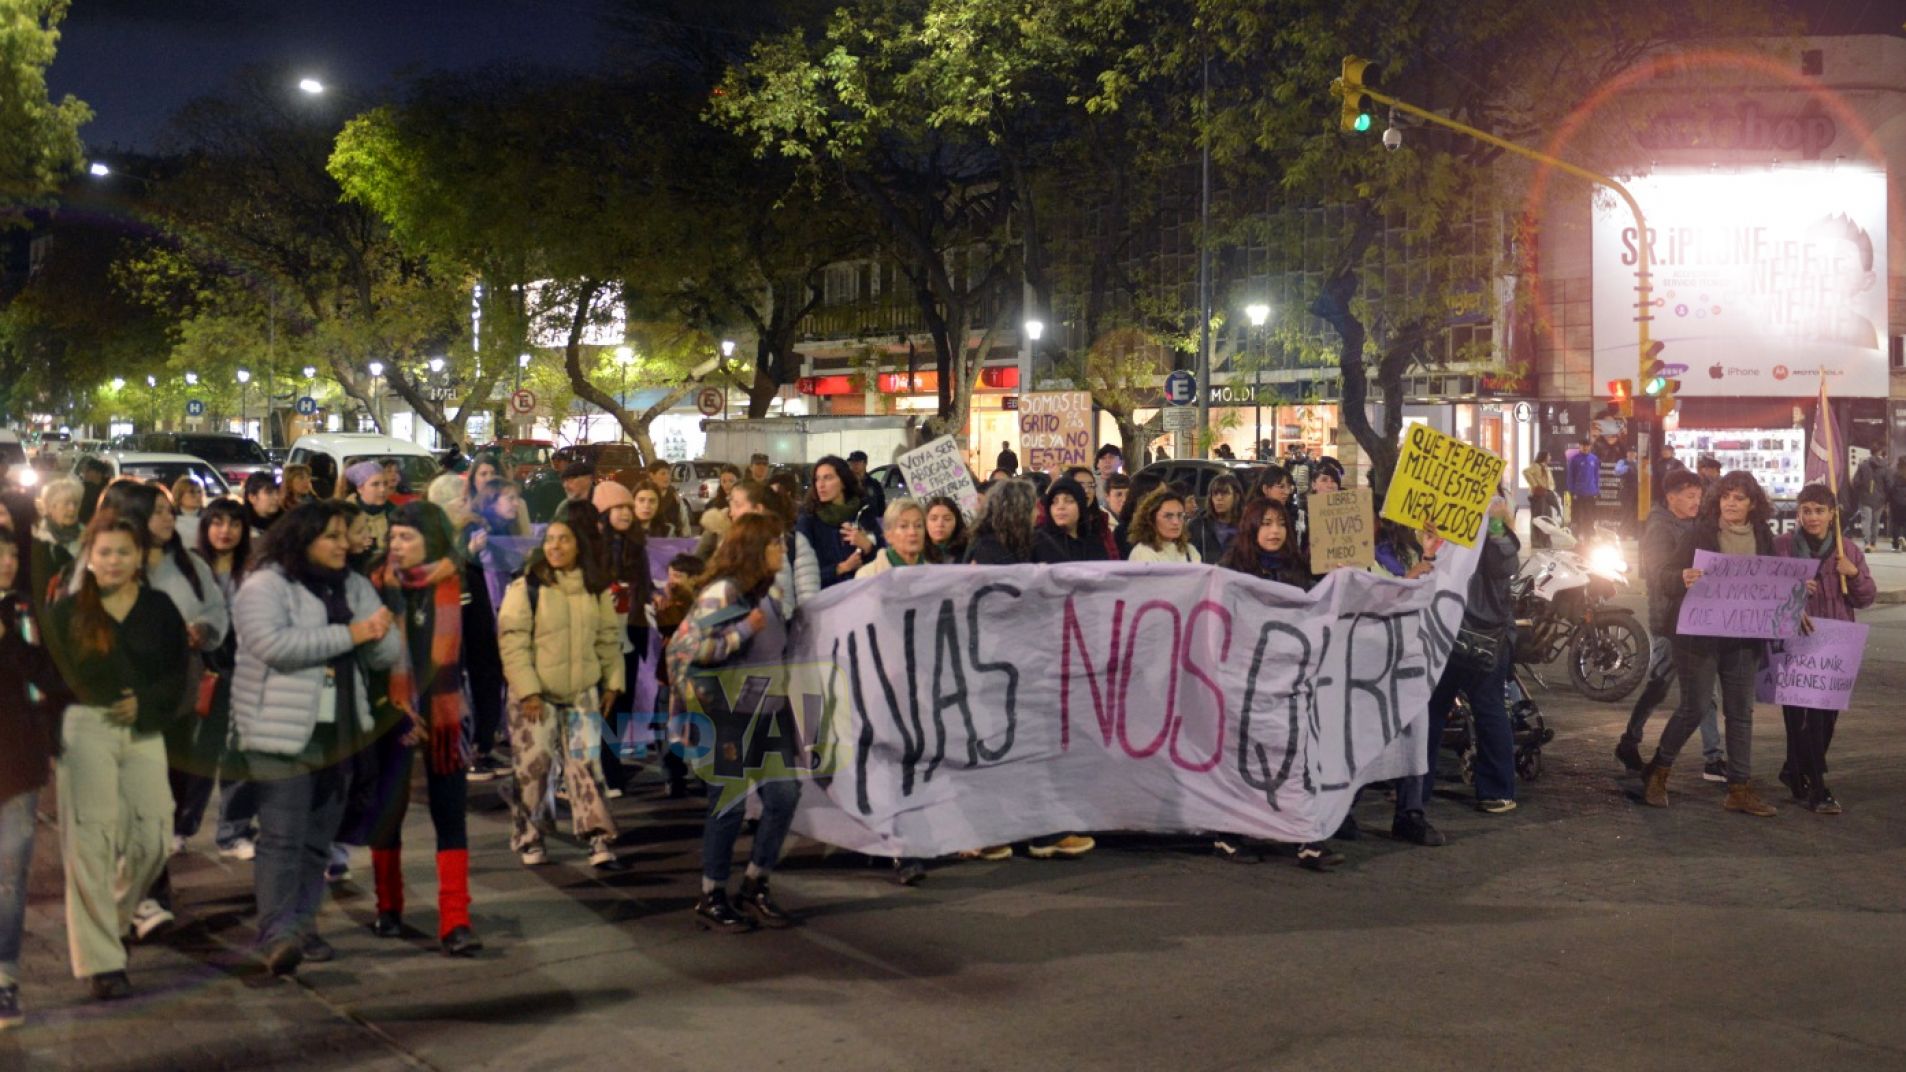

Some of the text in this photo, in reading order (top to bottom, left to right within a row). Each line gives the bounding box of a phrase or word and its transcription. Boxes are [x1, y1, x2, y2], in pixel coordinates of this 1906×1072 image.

[1727, 368, 1760, 378] iPhone
[1172, 380, 1189, 400] E
[190, 403, 200, 412] H
[301, 400, 311, 412] H
[1021, 392, 1090, 414] SOMOS EL
[1021, 414, 1060, 433] GRITO
[1021, 430, 1089, 448] QUE YA NO
[1412, 428, 1502, 482] QUE TE PASA
[1400, 487, 1483, 542] NERVIOSO
[1325, 514, 1364, 535] VIVAS
[1326, 544, 1356, 559] MIEDO
[1703, 557, 1762, 577] SOMOS
[1703, 584, 1720, 599] LA
[1687, 607, 1713, 626] QUE
[1785, 653, 1817, 668] PARA
[1060, 599, 1232, 774] NOS
